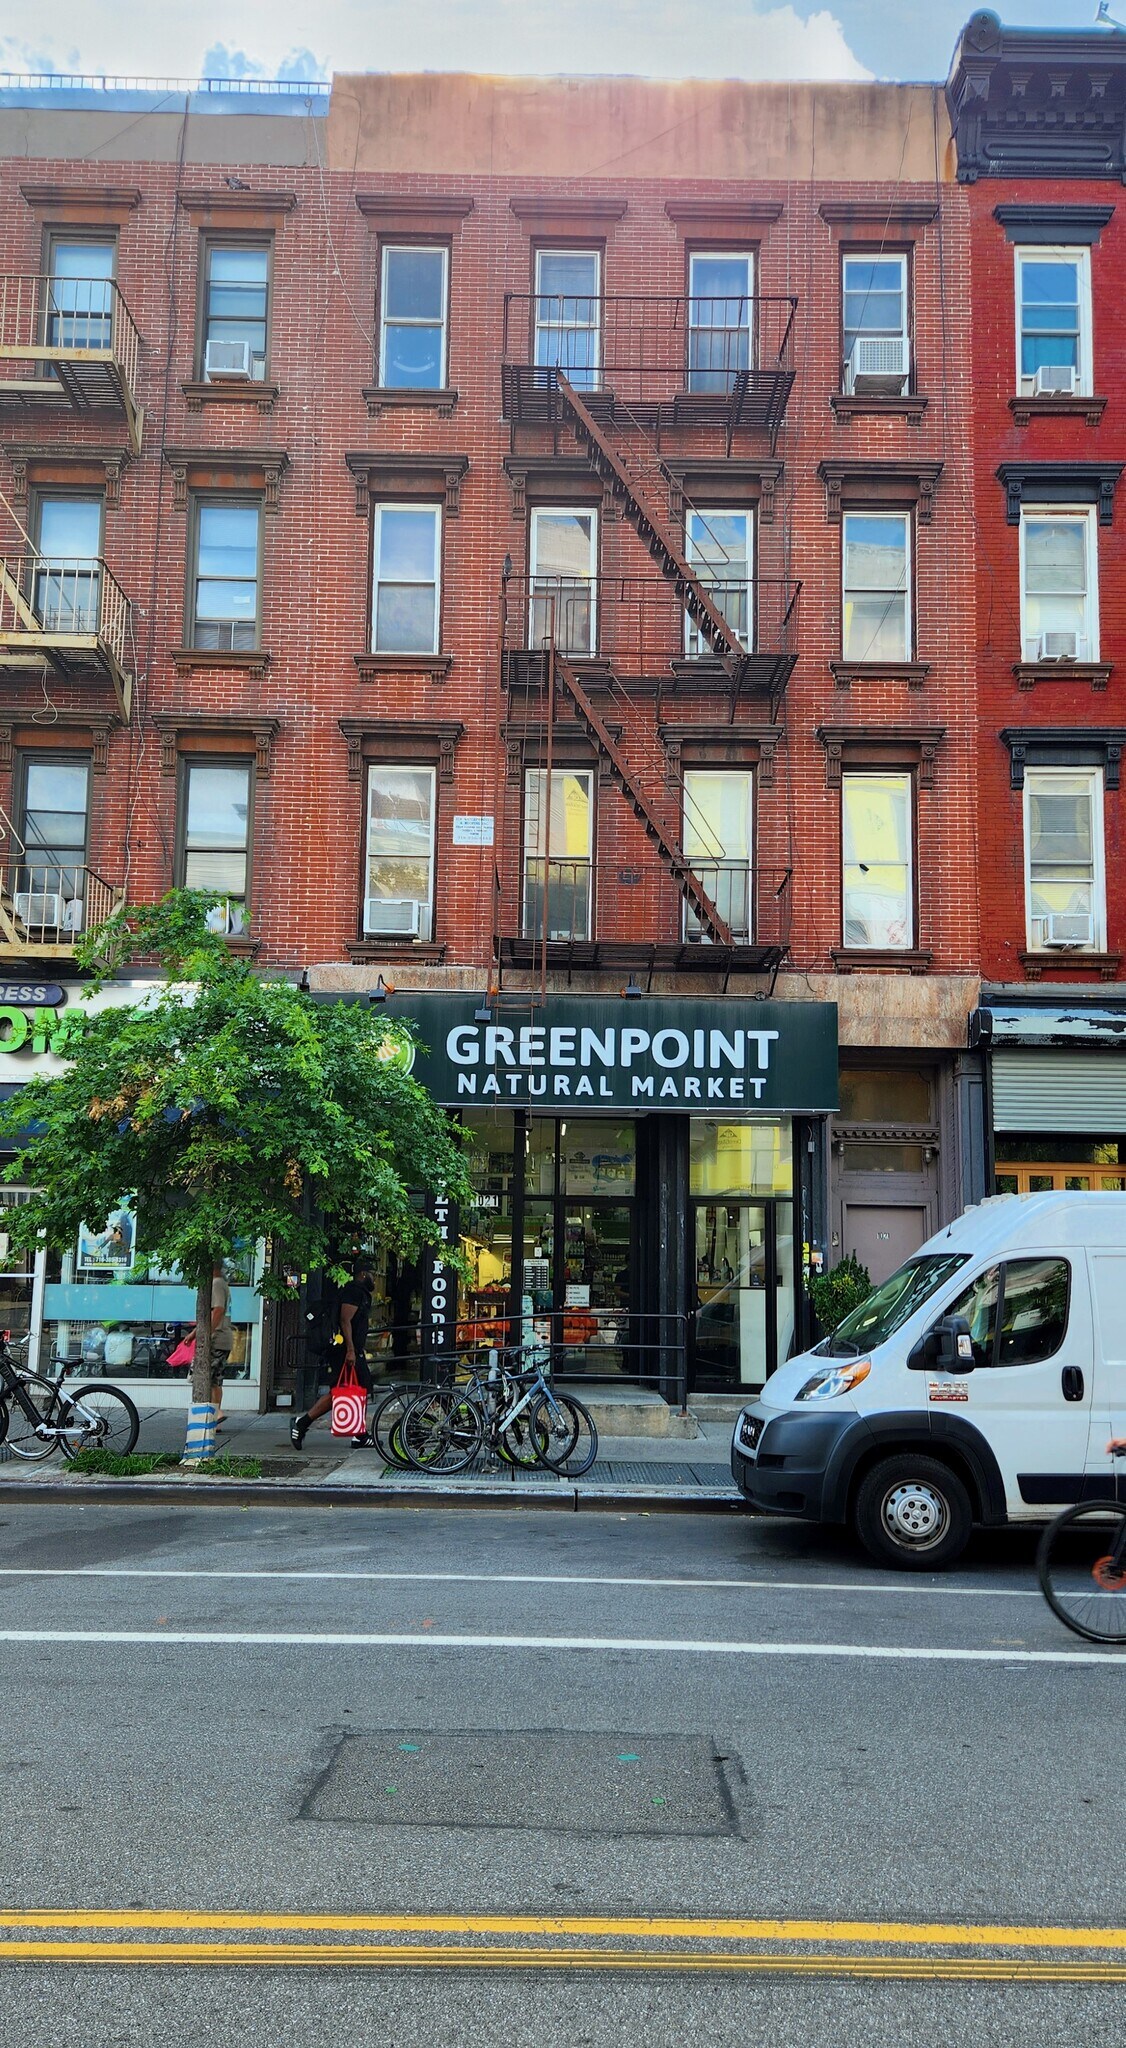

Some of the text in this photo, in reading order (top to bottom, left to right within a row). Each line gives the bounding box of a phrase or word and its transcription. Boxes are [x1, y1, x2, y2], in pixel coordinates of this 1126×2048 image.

[446, 1025, 779, 1070] GREENPOINT
[457, 1073, 767, 1099] NATURAL MARKET
[430, 1260, 448, 1345] FOODS
